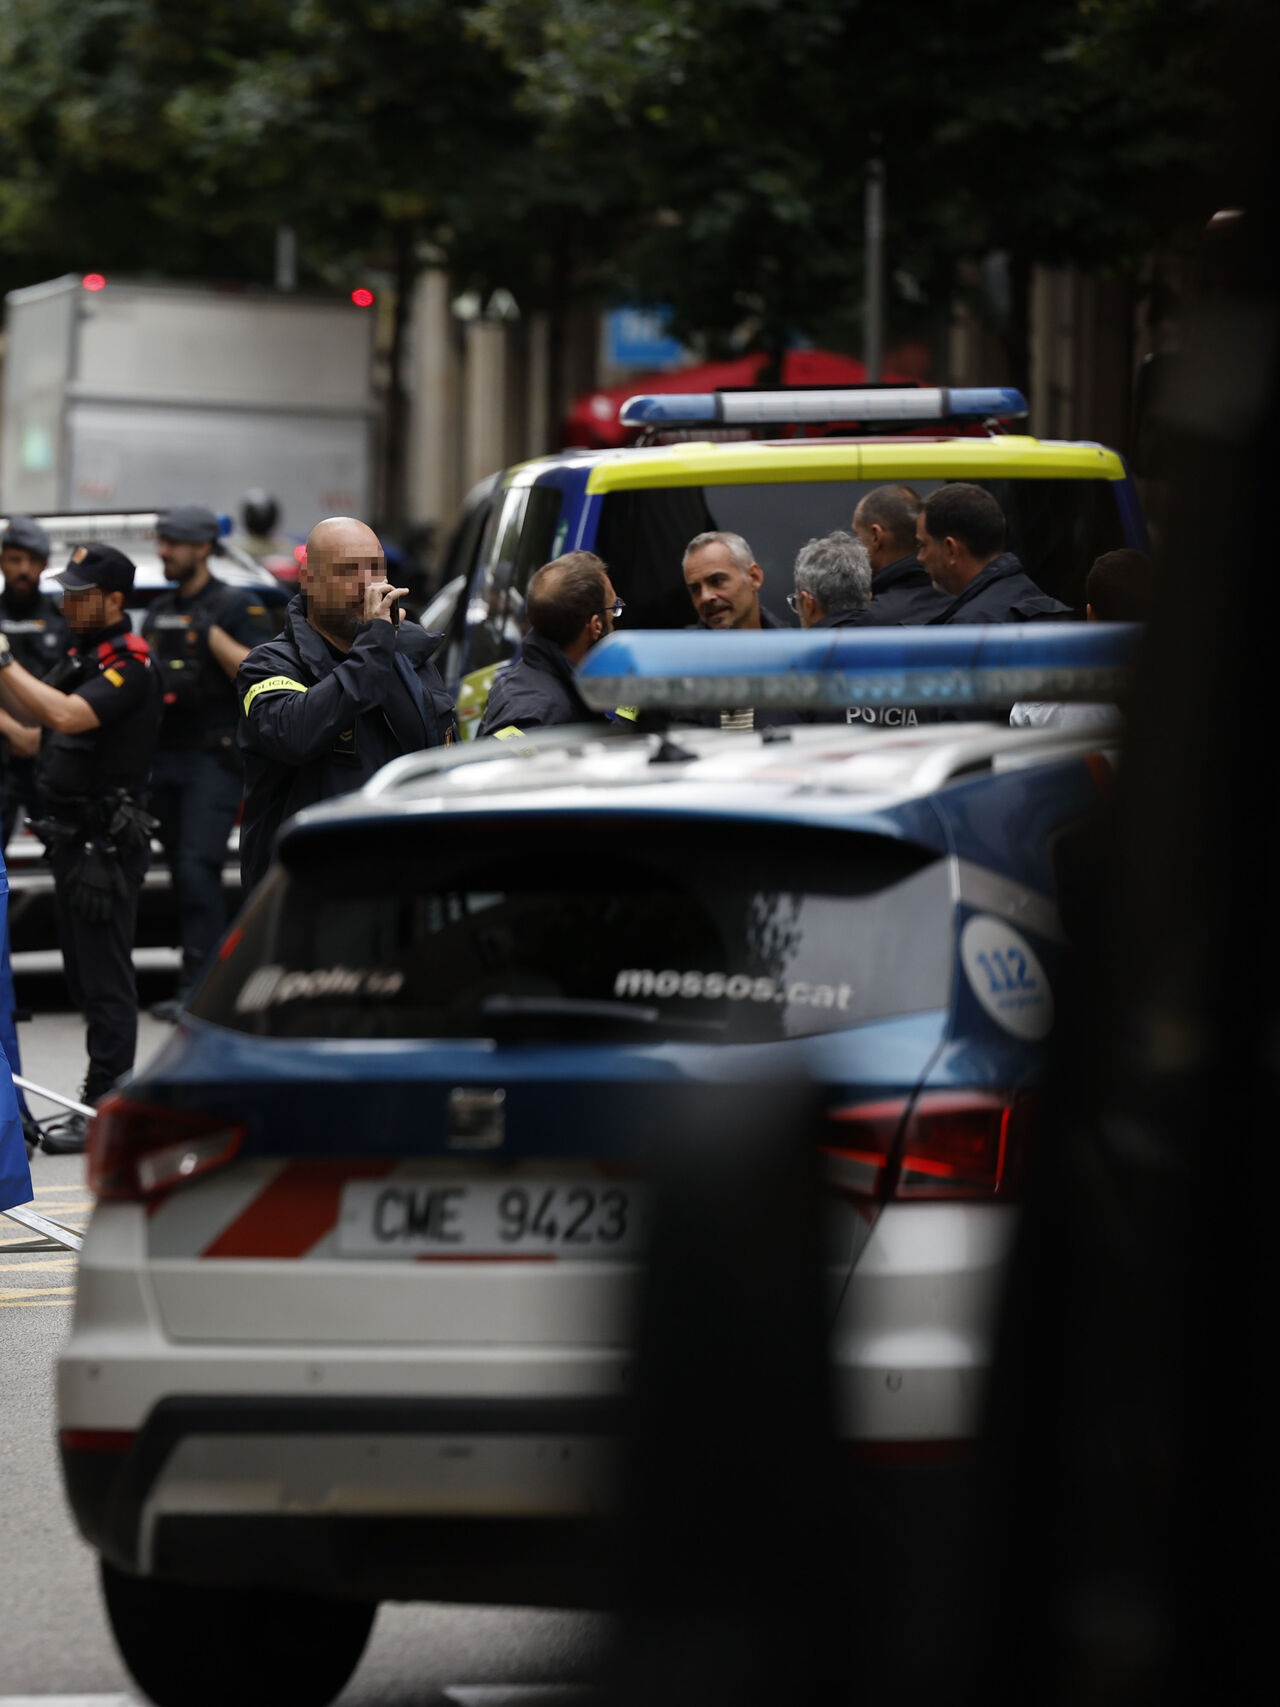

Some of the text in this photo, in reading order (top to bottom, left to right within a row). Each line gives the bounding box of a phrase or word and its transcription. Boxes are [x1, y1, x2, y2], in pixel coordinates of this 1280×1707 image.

[614, 969, 853, 1011] mossos.cat
[976, 948, 1037, 994] 112
[373, 1187, 628, 1244] CME 9423
